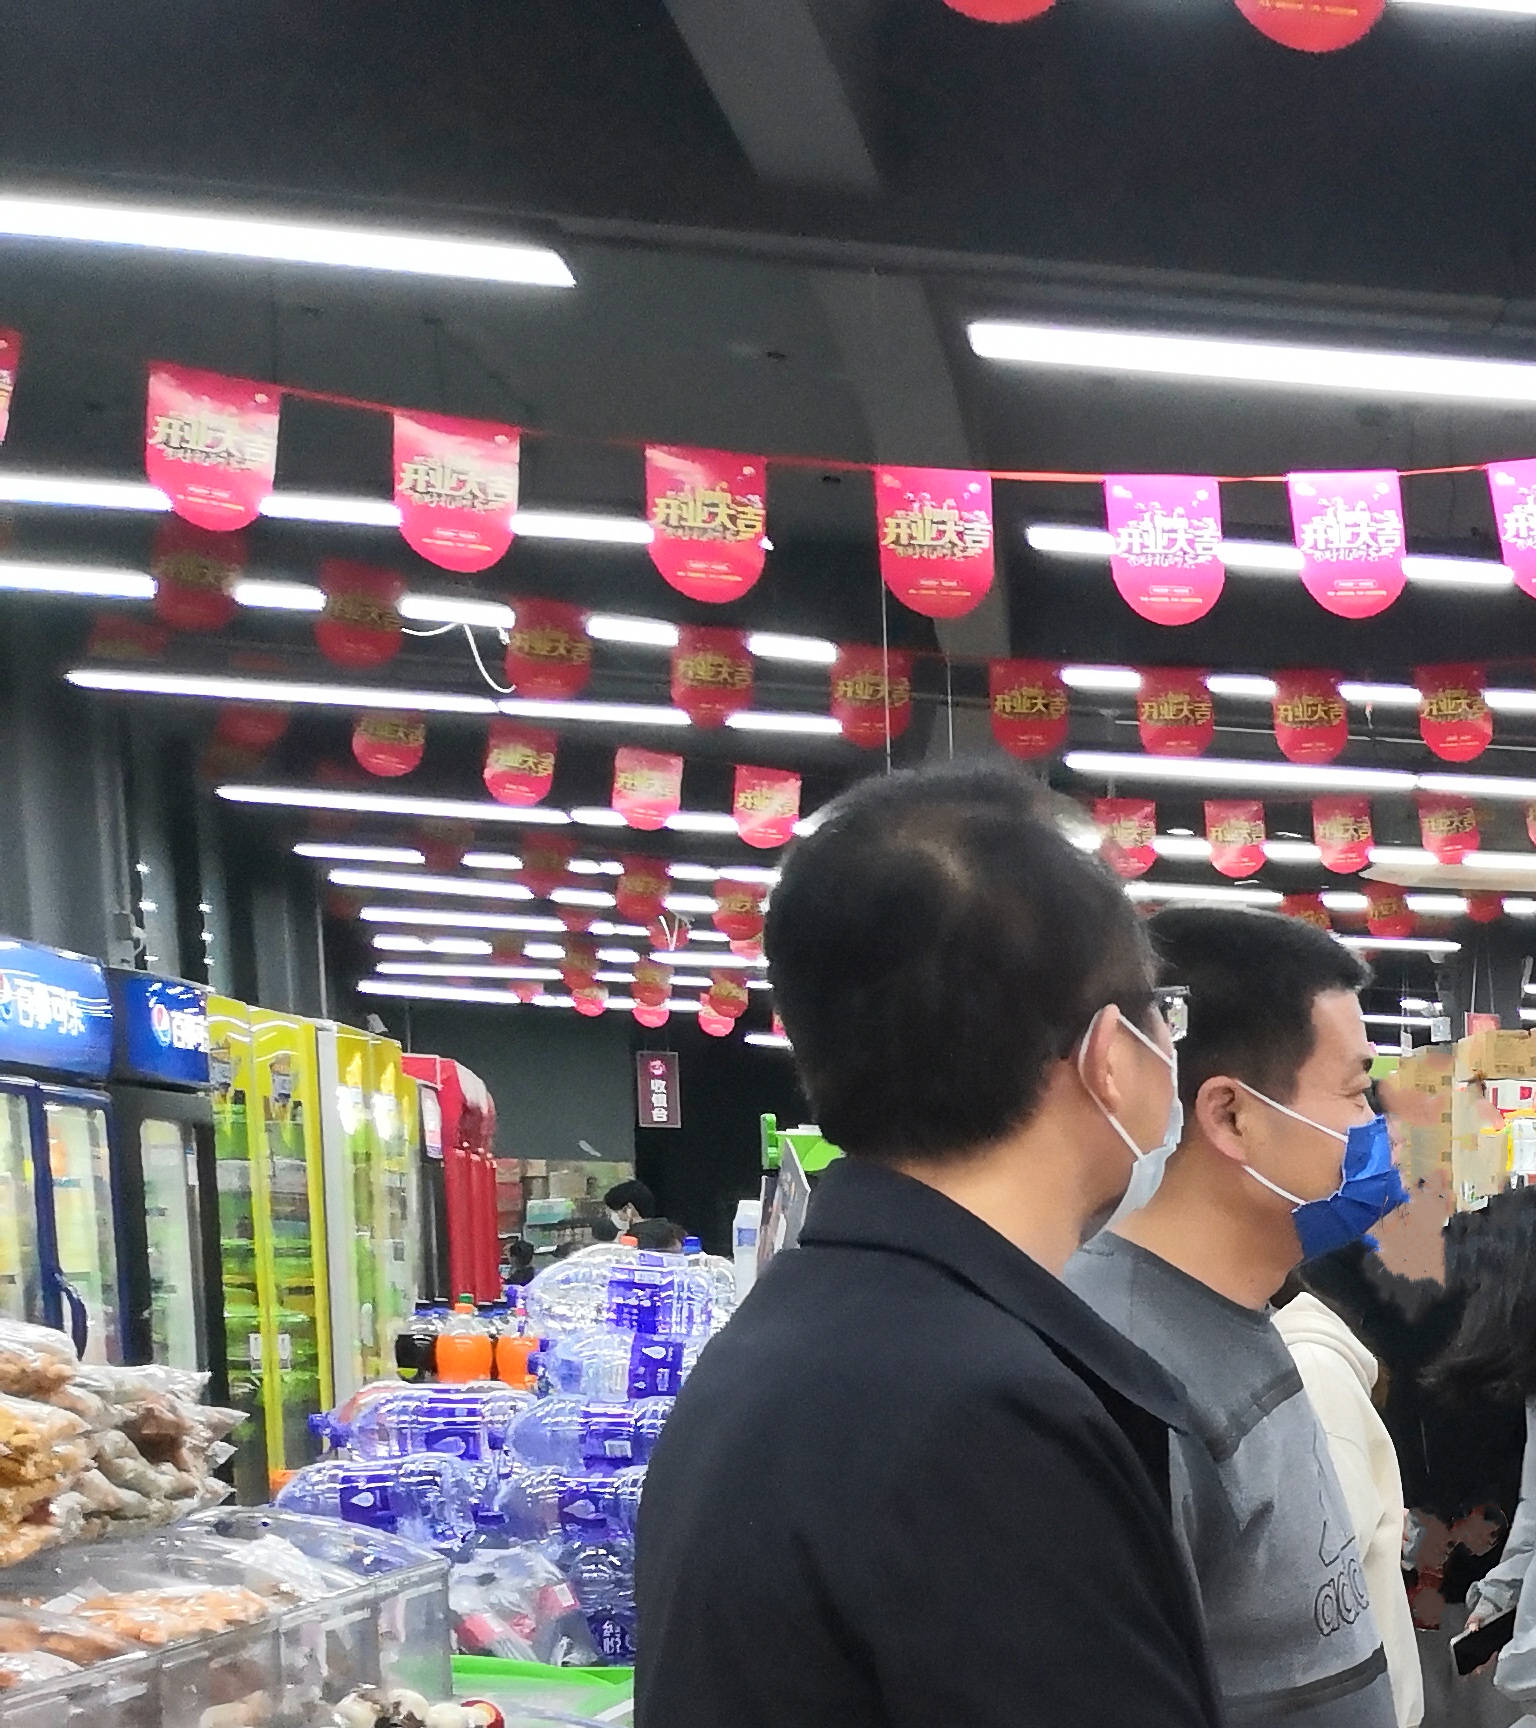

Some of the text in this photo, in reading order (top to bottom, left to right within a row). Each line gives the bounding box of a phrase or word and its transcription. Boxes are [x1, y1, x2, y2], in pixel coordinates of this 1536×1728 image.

[153, 414, 273, 462] 开业大吉
[400, 458, 517, 505] 开业大吉
[653, 488, 765, 541] 开业大吉
[882, 500, 992, 549] 开业大吉
[1118, 508, 1221, 556] 开业大吉
[1303, 504, 1404, 551] 开业大吉
